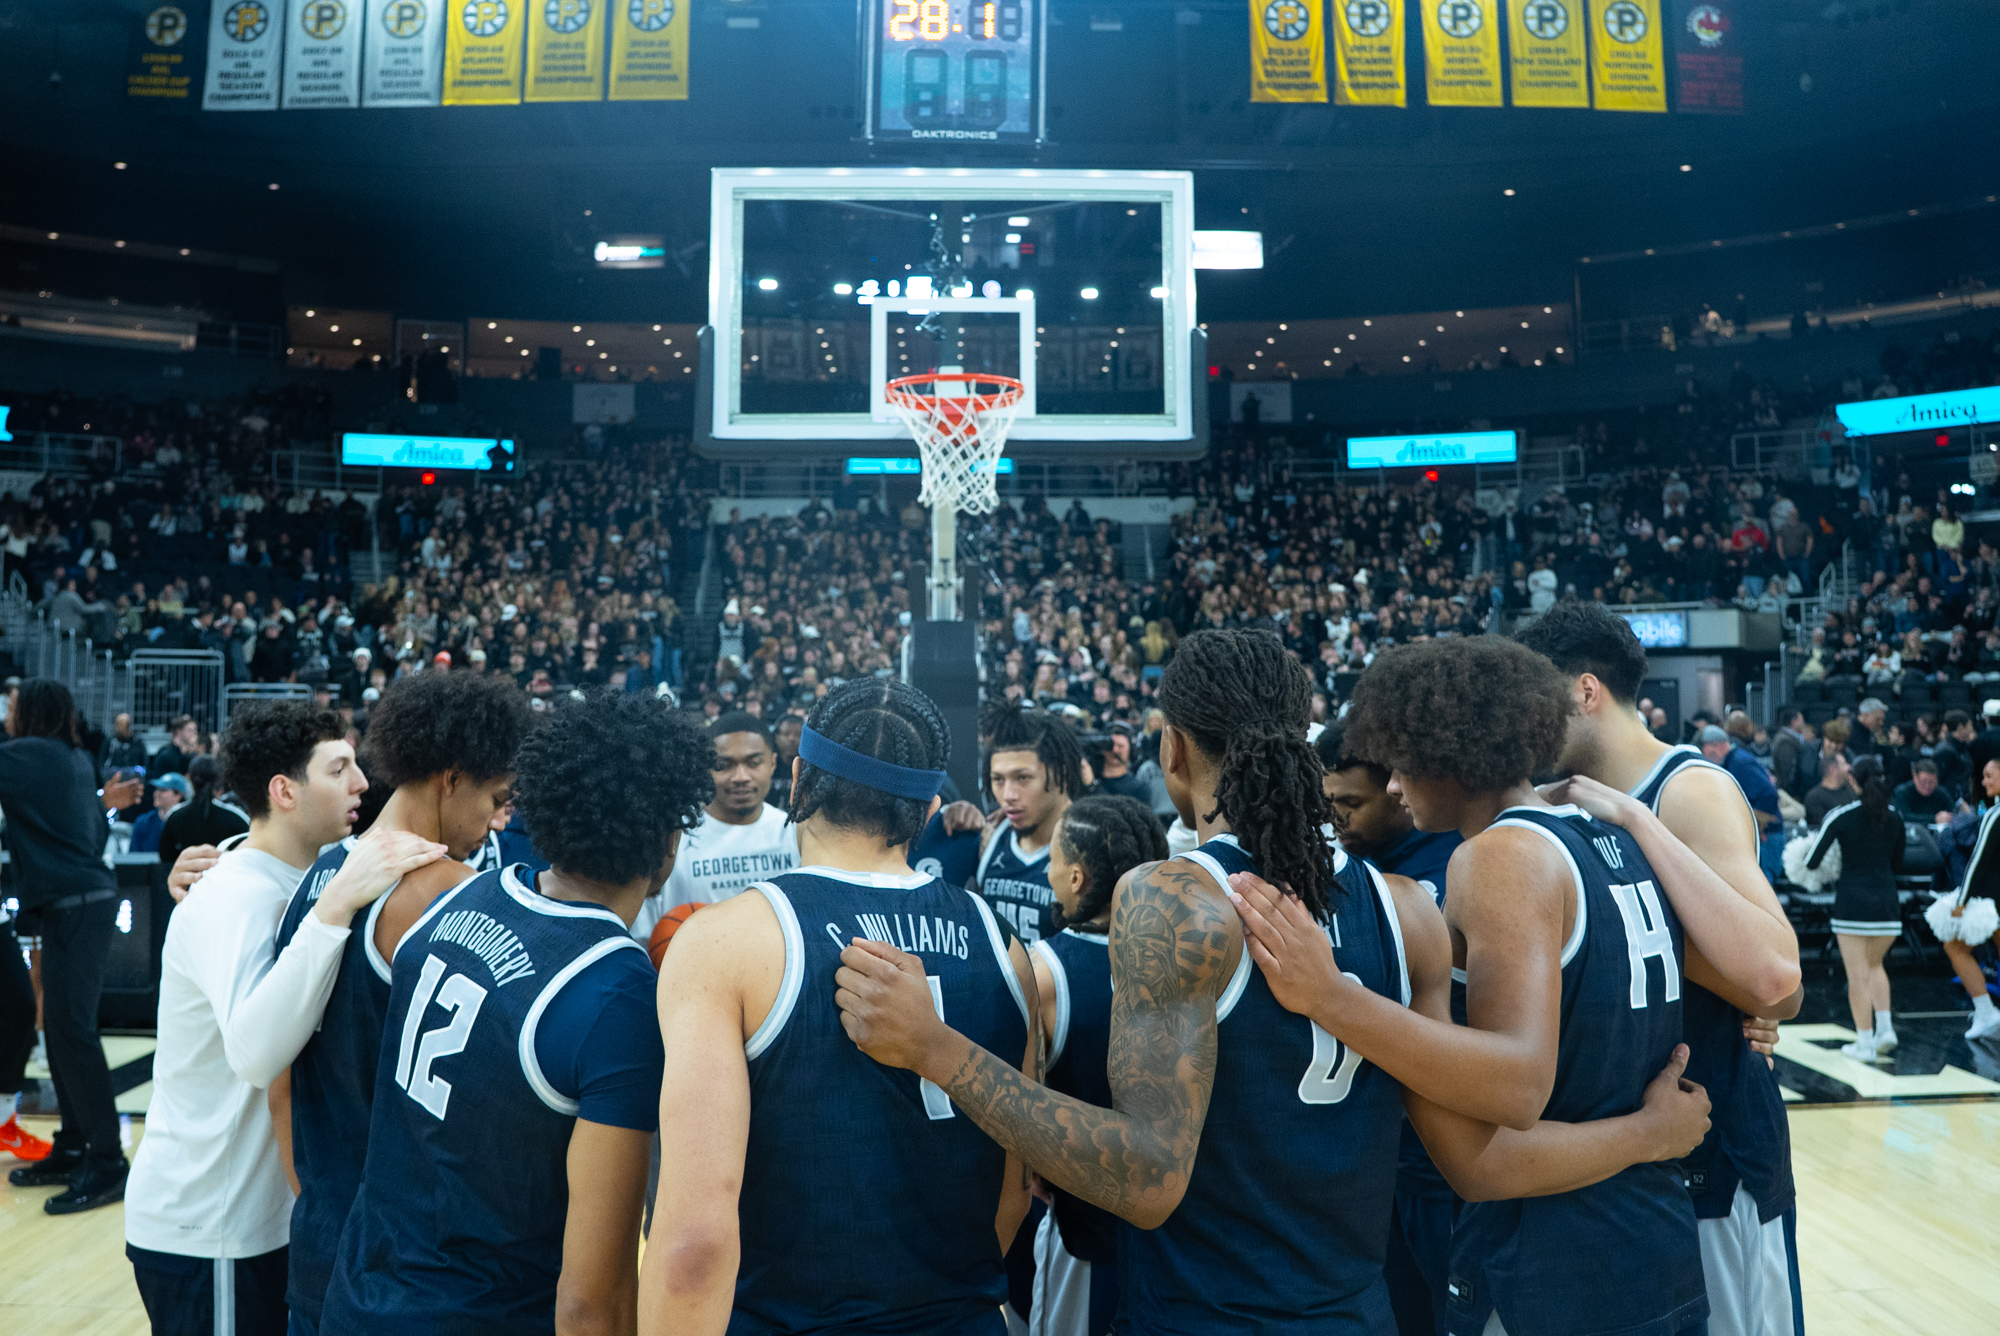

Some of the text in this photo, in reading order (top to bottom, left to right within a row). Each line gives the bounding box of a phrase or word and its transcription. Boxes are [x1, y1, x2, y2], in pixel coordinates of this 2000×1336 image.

[912, 130, 998, 140] DAKTRONICS
[1896, 401, 1976, 425] Amica
[394, 441, 463, 463] Amica
[1396, 440, 1466, 462] Amica
[1634, 620, 1682, 641] obile
[692, 853, 792, 878] GEORGETOWN
[983, 877, 1058, 907] GEORGETOWN
[429, 910, 536, 988] MONTGOMERY
[855, 914, 969, 960] WILLIAMS
[1609, 880, 1680, 1009] 4
[395, 953, 488, 1121] 12
